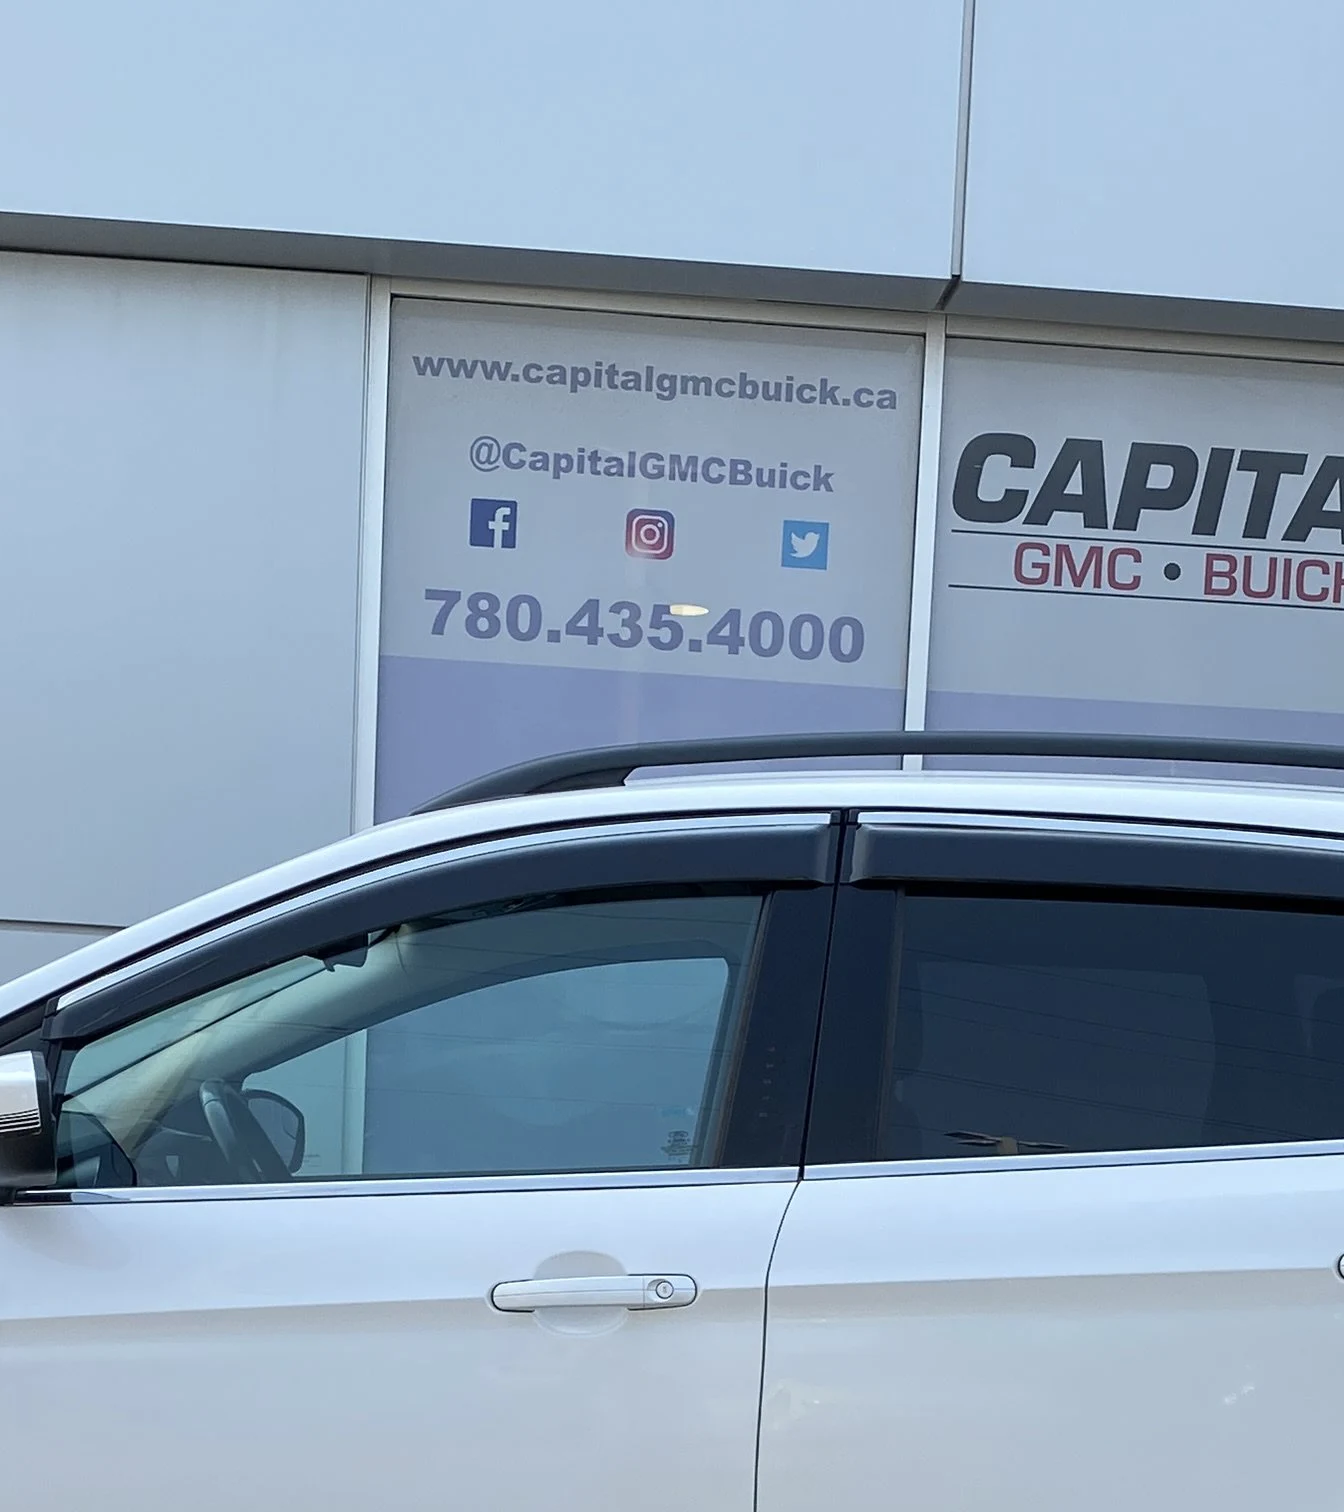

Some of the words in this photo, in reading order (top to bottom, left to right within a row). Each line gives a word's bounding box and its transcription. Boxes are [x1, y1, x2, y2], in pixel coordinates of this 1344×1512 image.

[411, 354, 898, 411] www.capitalgmcbuick.ca
[469, 435, 835, 494] @CapitalGMCBuick
[1014, 541, 1142, 592] GMC
[423, 588, 865, 663] 780.435.4000
